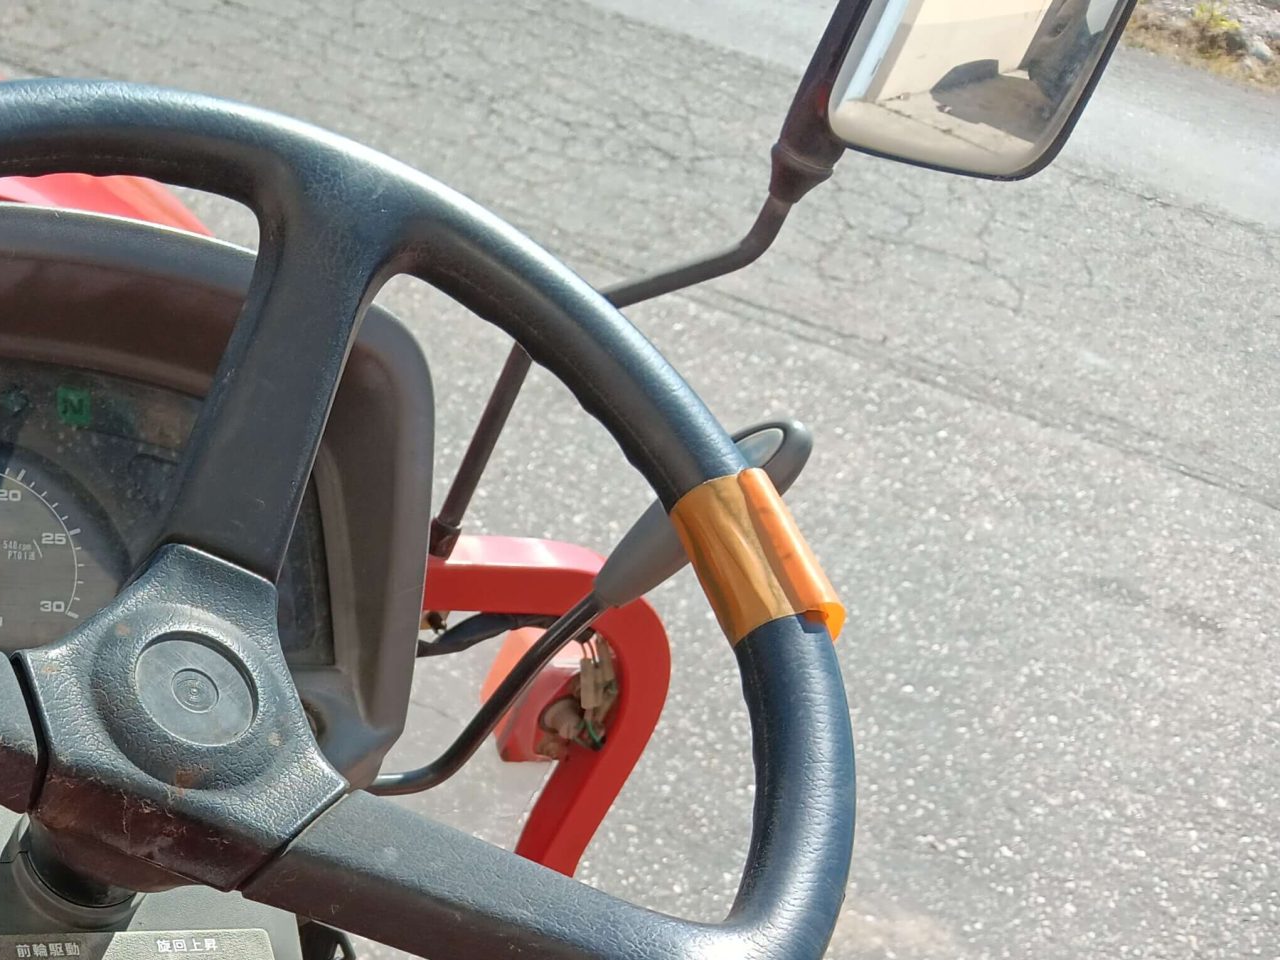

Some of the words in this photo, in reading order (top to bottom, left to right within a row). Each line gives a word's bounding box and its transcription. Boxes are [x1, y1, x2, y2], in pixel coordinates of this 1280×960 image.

[41, 532, 67, 546] 25
[40, 600, 65, 613] 30
[15, 942, 81, 958] 前輪駆動
[156, 938, 219, 954] 旋回上昇
